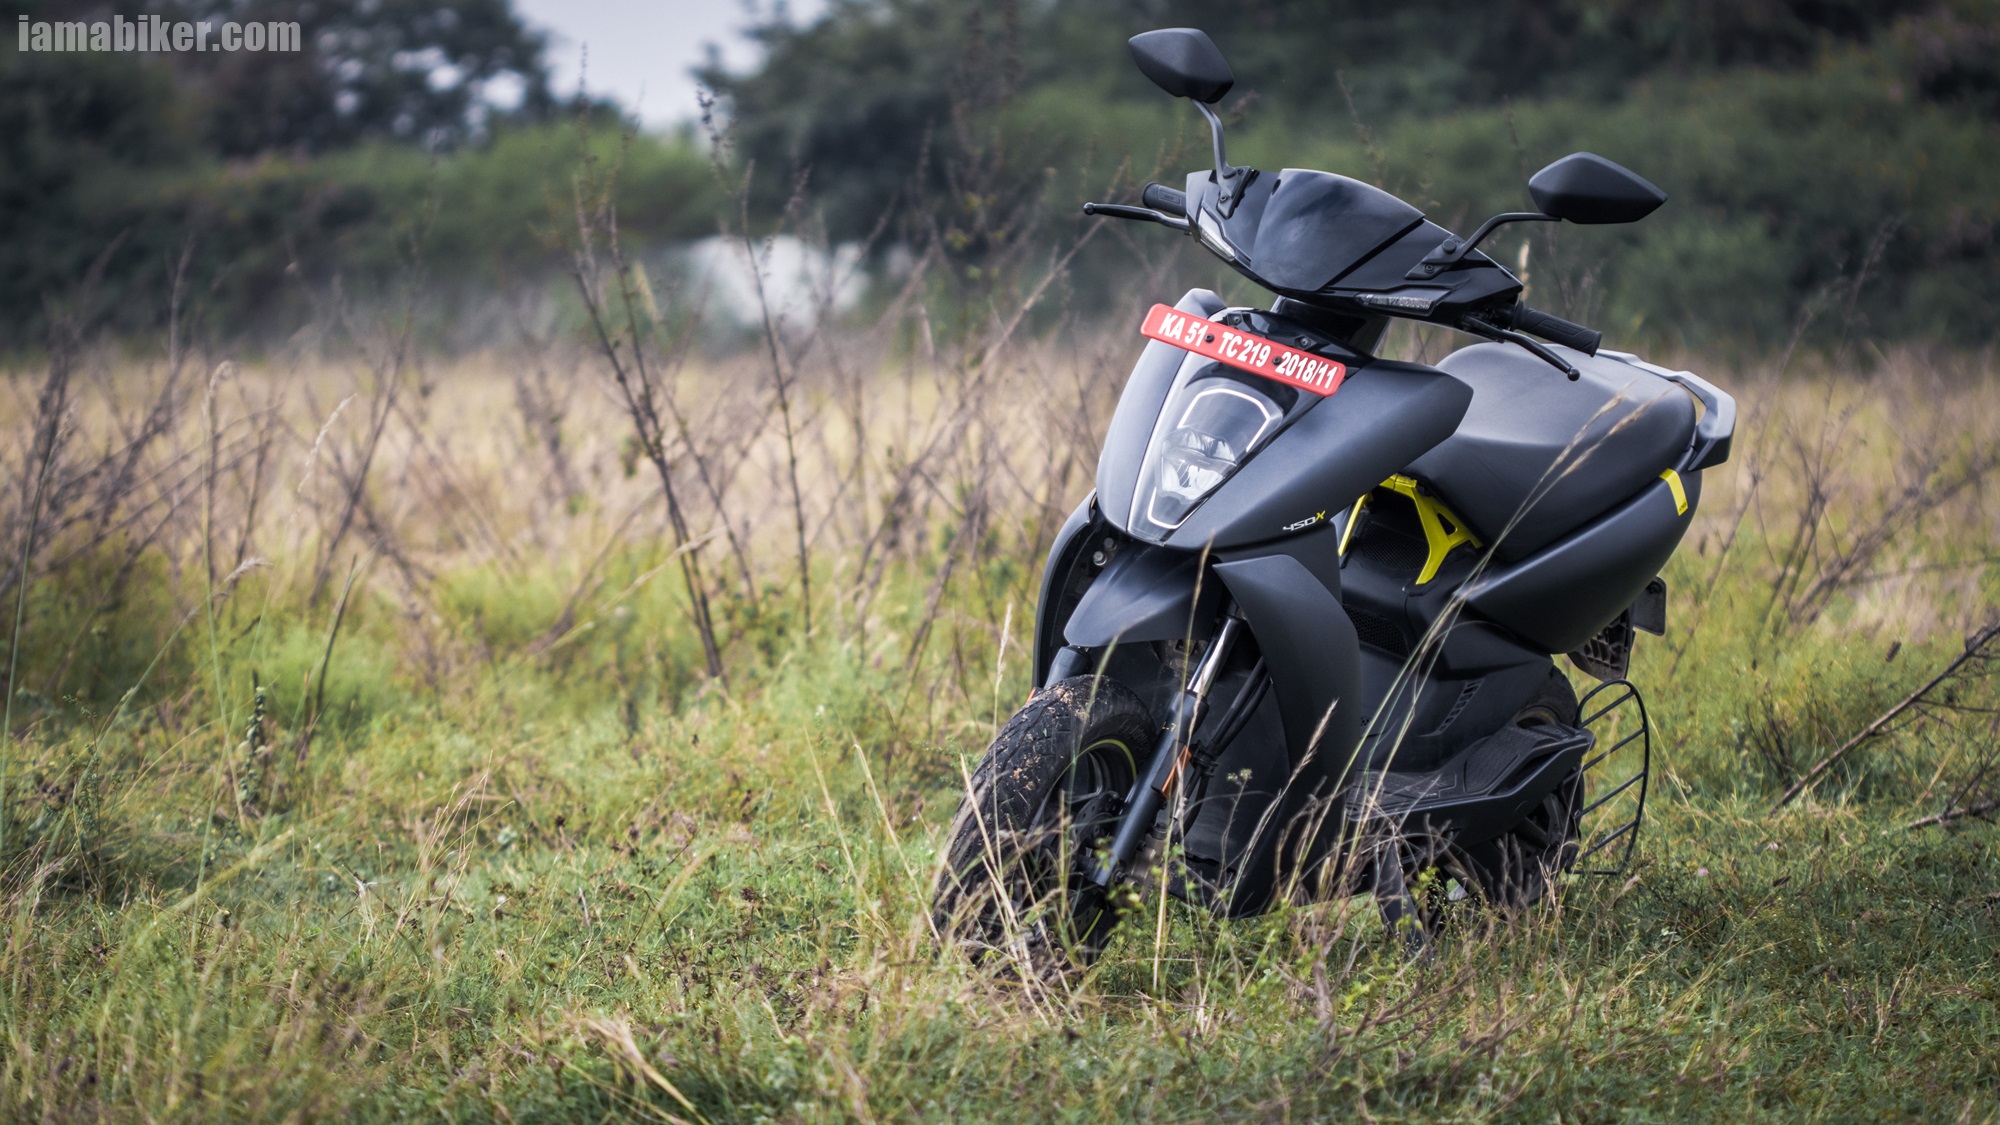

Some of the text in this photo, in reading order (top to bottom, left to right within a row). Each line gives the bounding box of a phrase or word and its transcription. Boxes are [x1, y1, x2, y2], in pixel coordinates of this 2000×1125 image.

[1158, 312, 1186, 341] KA
[1184, 322, 1209, 347] 51
[1275, 351, 1338, 389] 2018/11
[1282, 510, 1326, 531] 450X
